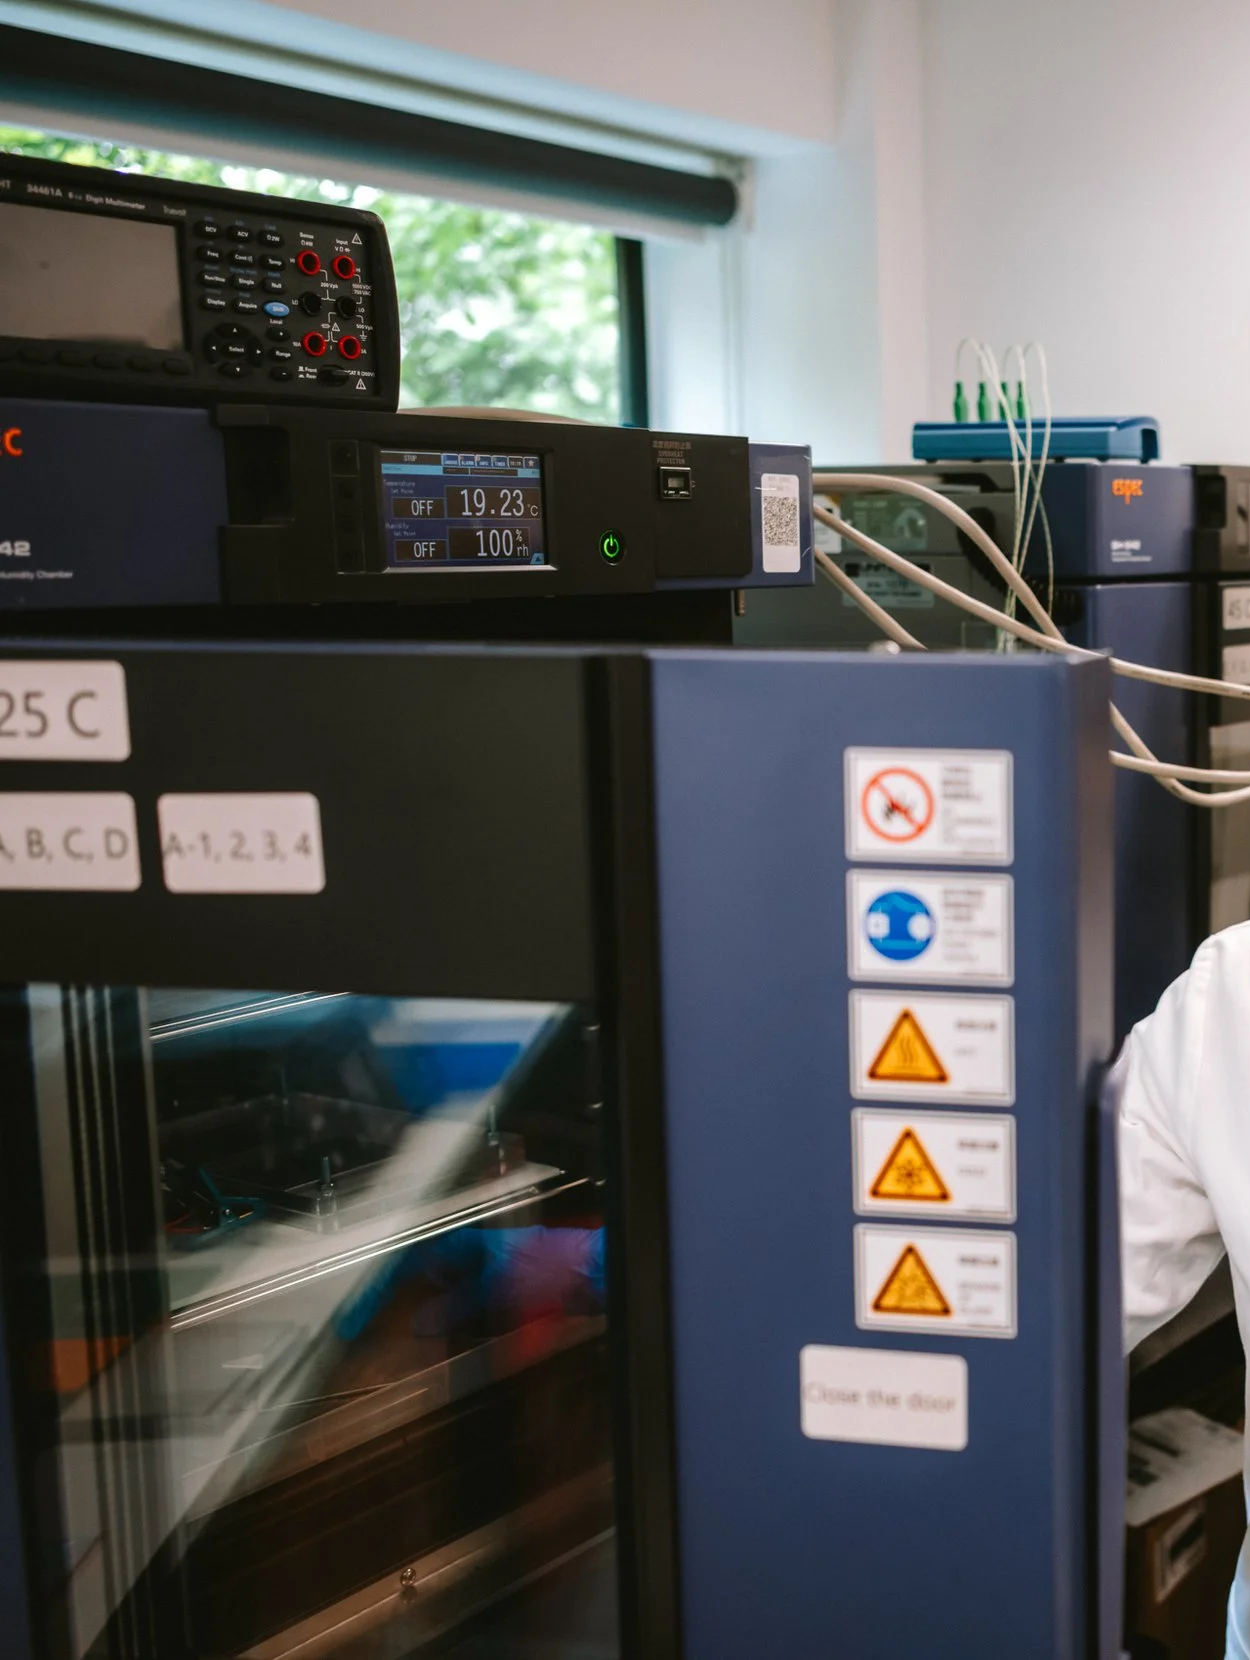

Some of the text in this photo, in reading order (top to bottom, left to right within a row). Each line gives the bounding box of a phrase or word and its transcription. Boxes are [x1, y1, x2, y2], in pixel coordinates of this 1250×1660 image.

[105, 197, 146, 210] Multimeter
[268, 258, 282, 266] Temp
[207, 298, 226, 306] Display
[275, 350, 291, 358] Range
[403, 454, 417, 463] STOP
[411, 499, 434, 516] OFF
[460, 488, 525, 517] 19.23
[413, 541, 436, 558] OFF
[475, 528, 514, 557] 100
[516, 544, 529, 557] rh
[36, 569, 74, 580] Chamber
[0, 689, 101, 739] 25 C
[103, 826, 130, 860] D
[805, 1381, 957, 1413] Close the door
